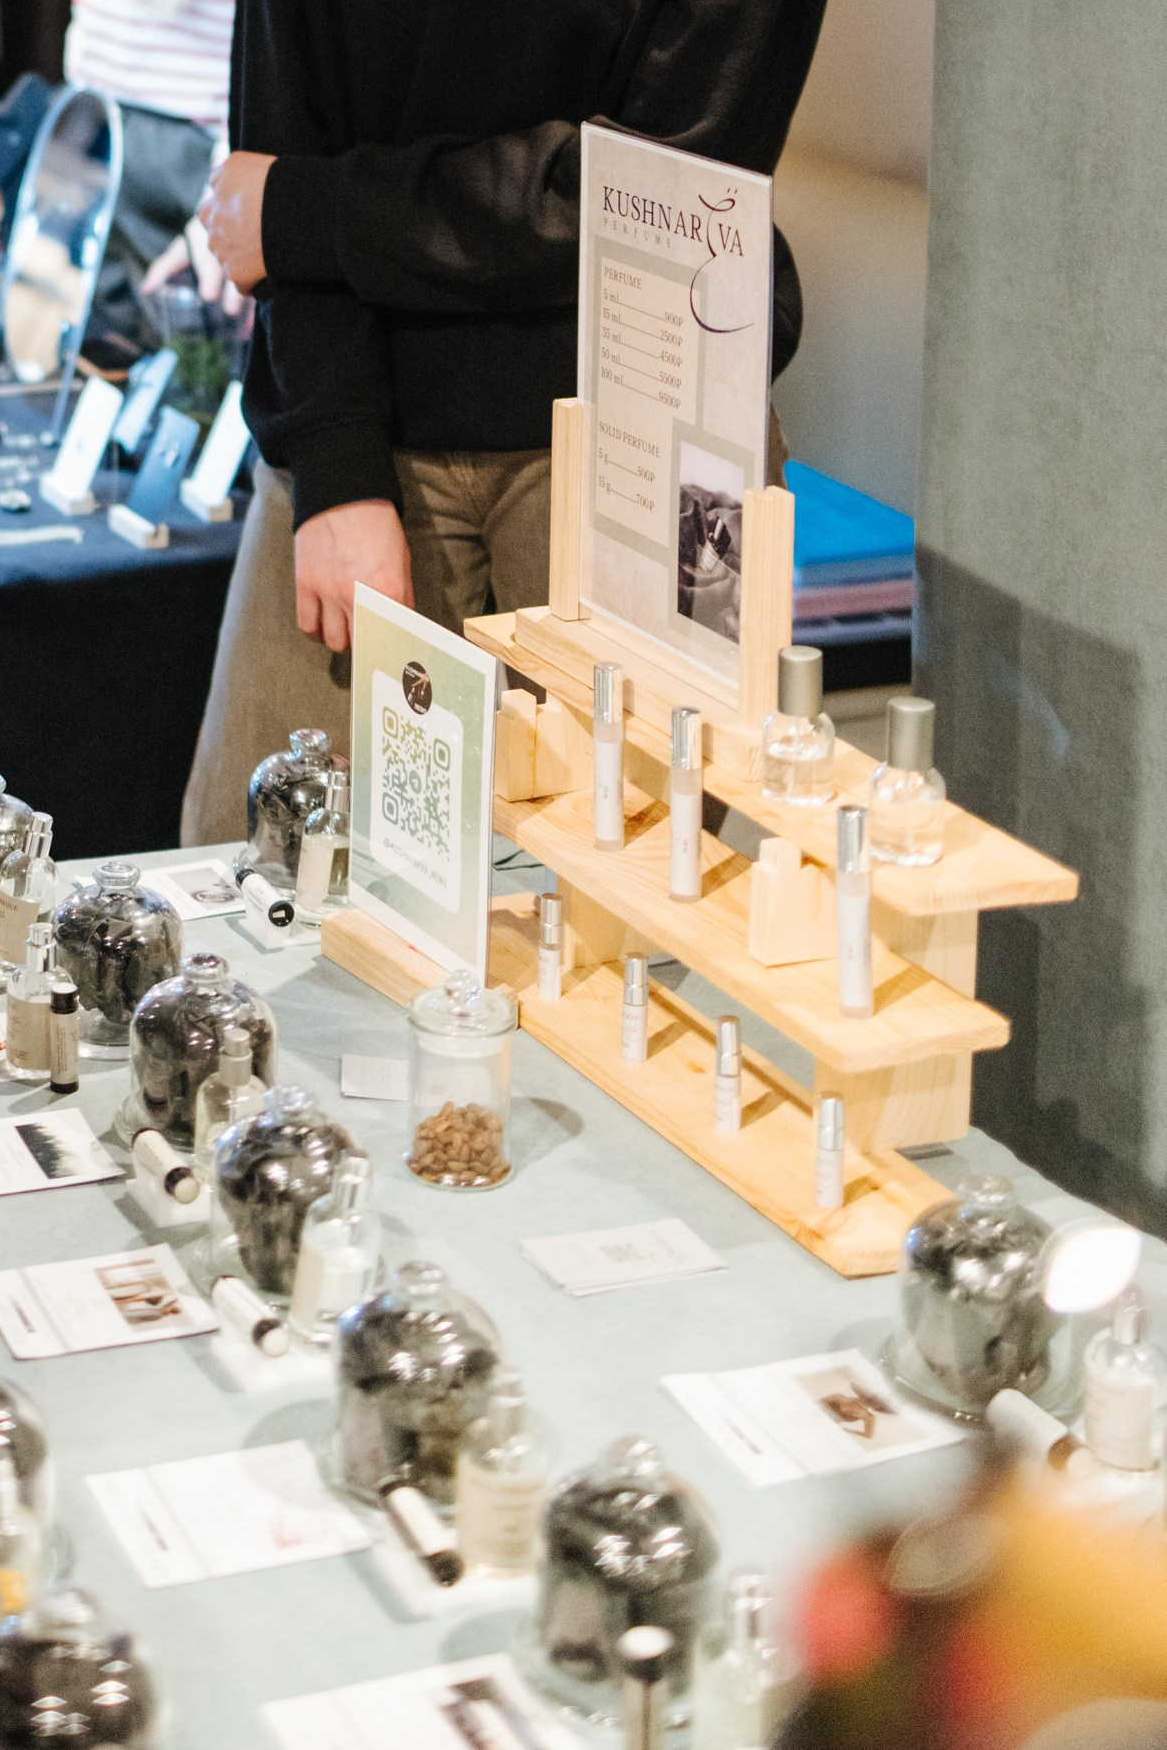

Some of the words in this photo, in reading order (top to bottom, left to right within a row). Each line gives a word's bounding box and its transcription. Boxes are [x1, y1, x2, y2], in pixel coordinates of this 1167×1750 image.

[603, 217, 671, 248] PERFUME
[604, 266, 641, 289] PERFUME
[603, 288, 608, 300] 5
[602, 307, 610, 320] 15
[601, 326, 610, 340] 35
[601, 347, 610, 360] 50
[601, 367, 613, 381] 100
[599, 421, 622, 440] SOLID
[622, 431, 661, 458] PERFUME
[598, 447, 603, 459] 5
[598, 475, 606, 488] 15
